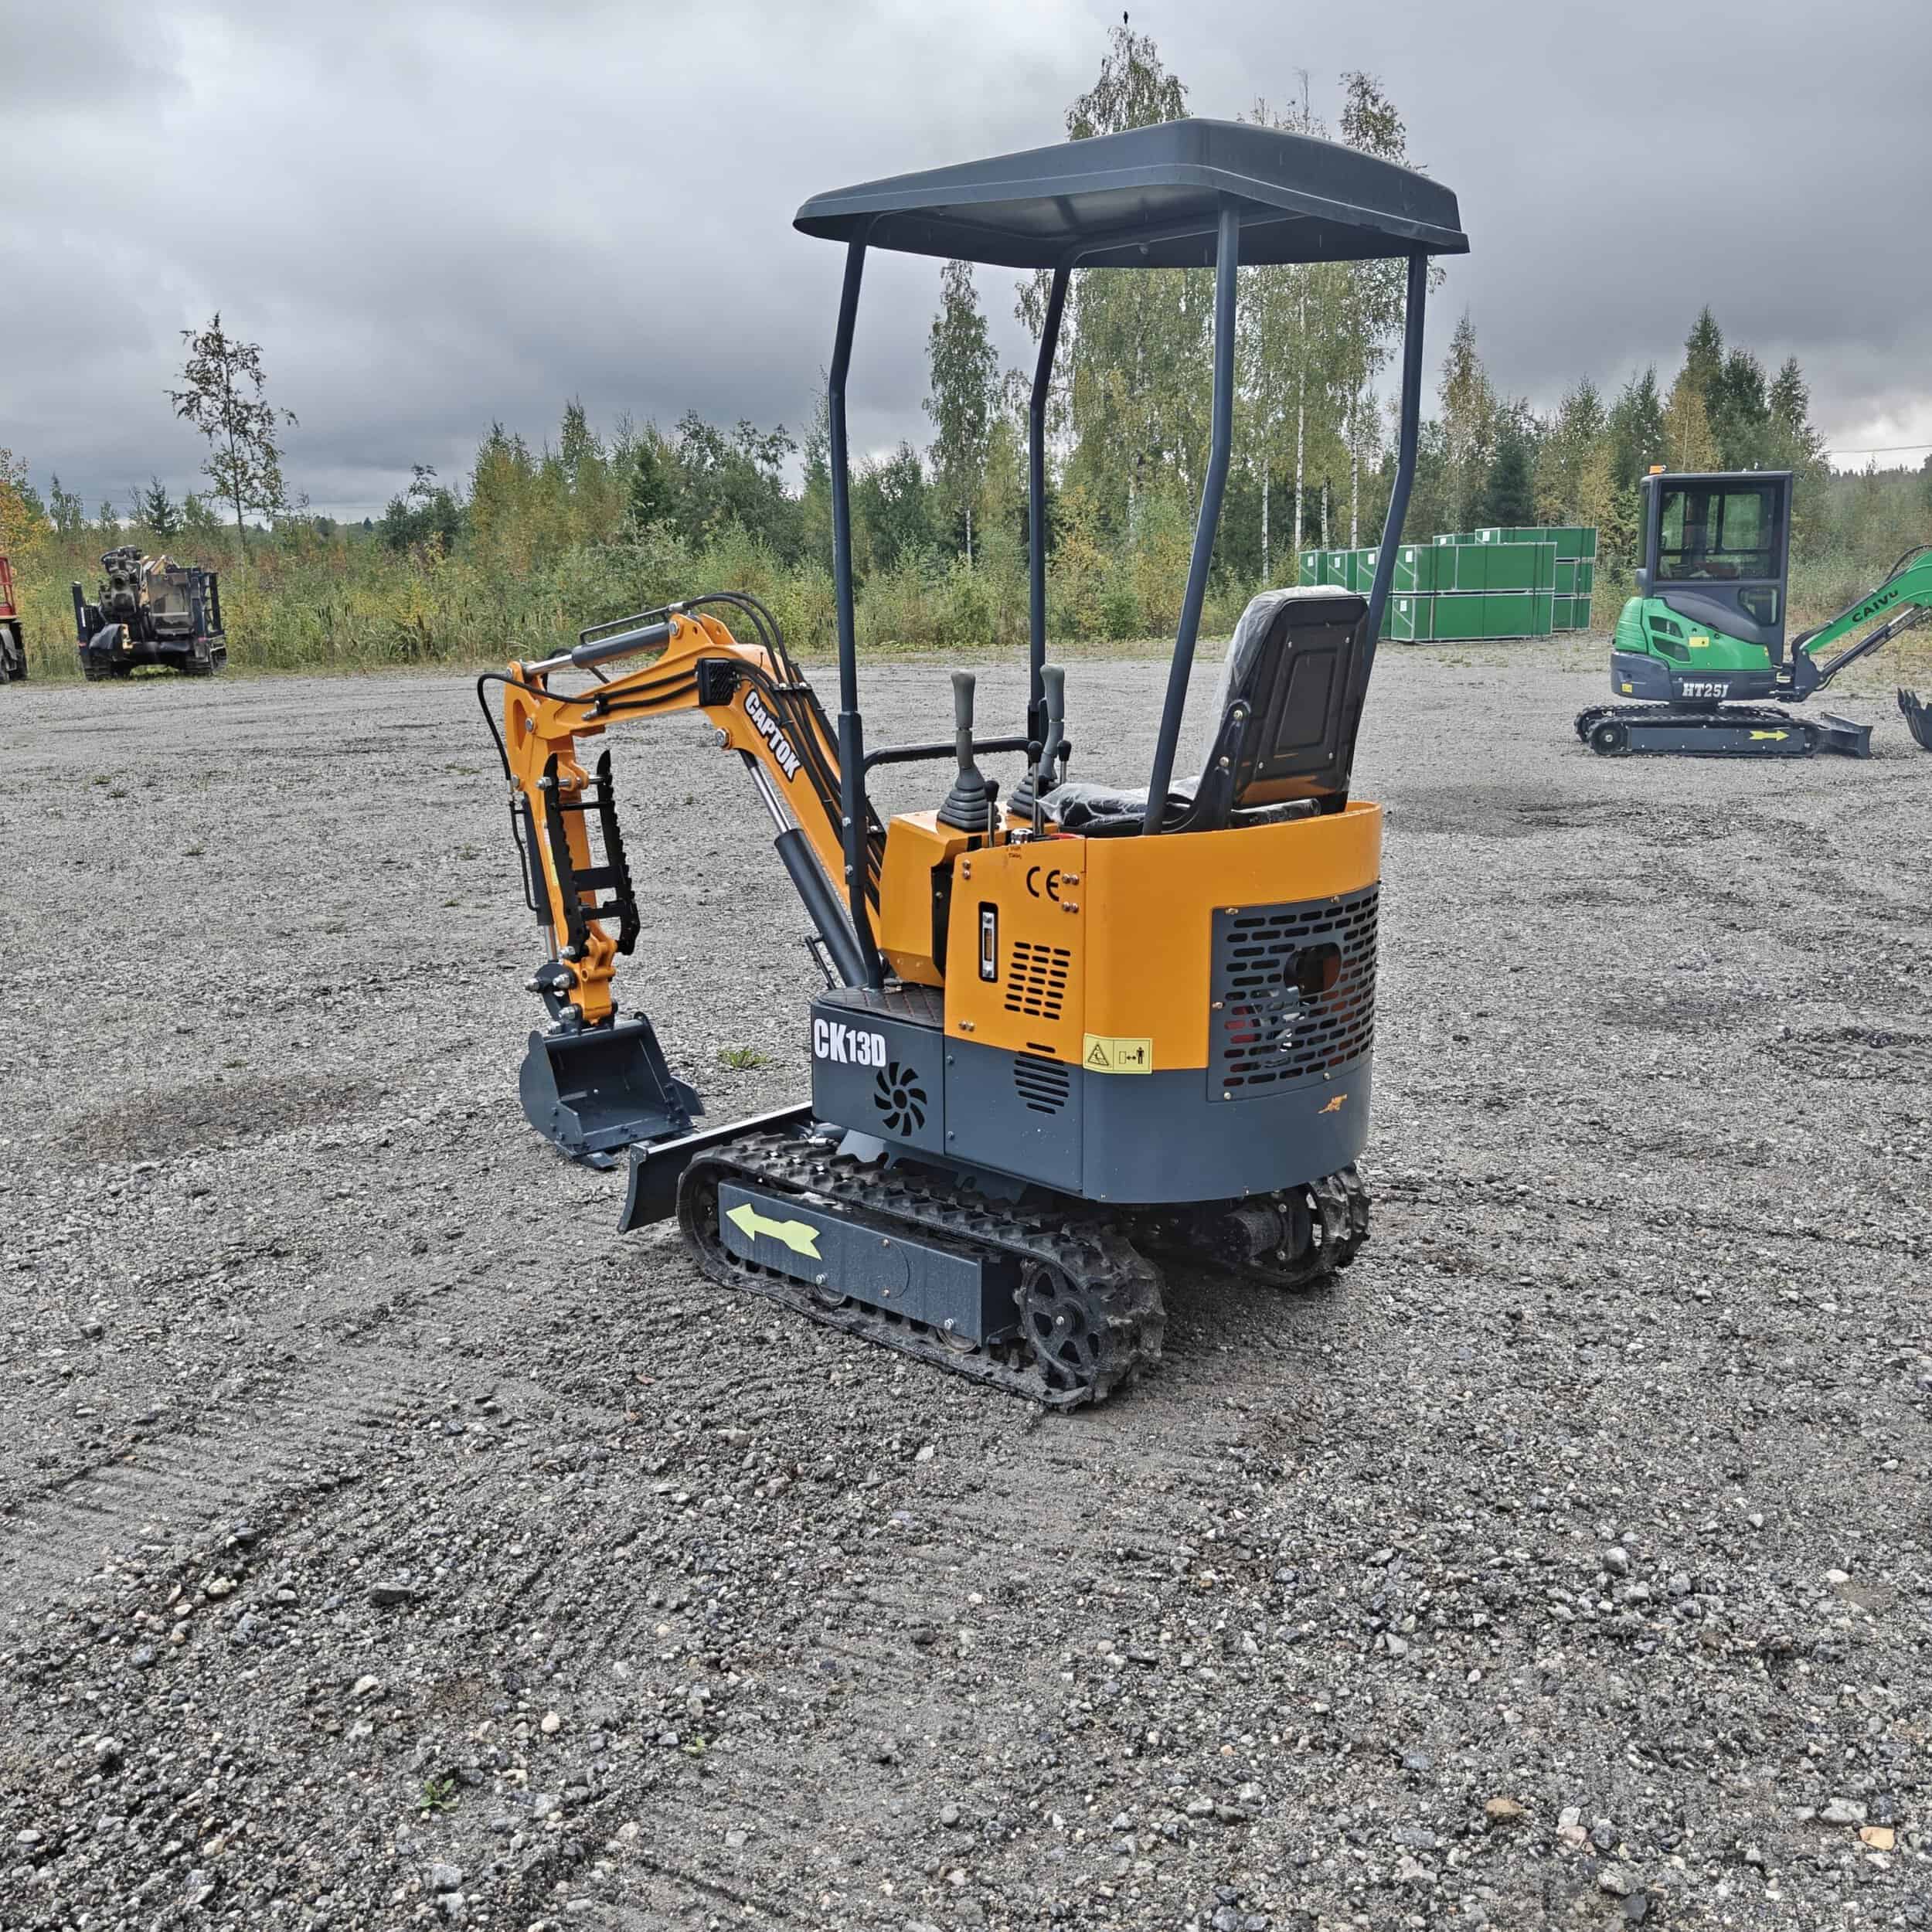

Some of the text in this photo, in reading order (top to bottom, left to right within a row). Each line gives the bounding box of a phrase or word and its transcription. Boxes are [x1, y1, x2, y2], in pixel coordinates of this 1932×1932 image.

[1682, 682, 1730, 698] HT25J
[744, 690, 801, 781] CAPTOK
[1026, 866, 1061, 902] CE
[814, 1019, 886, 1067] CK13D
